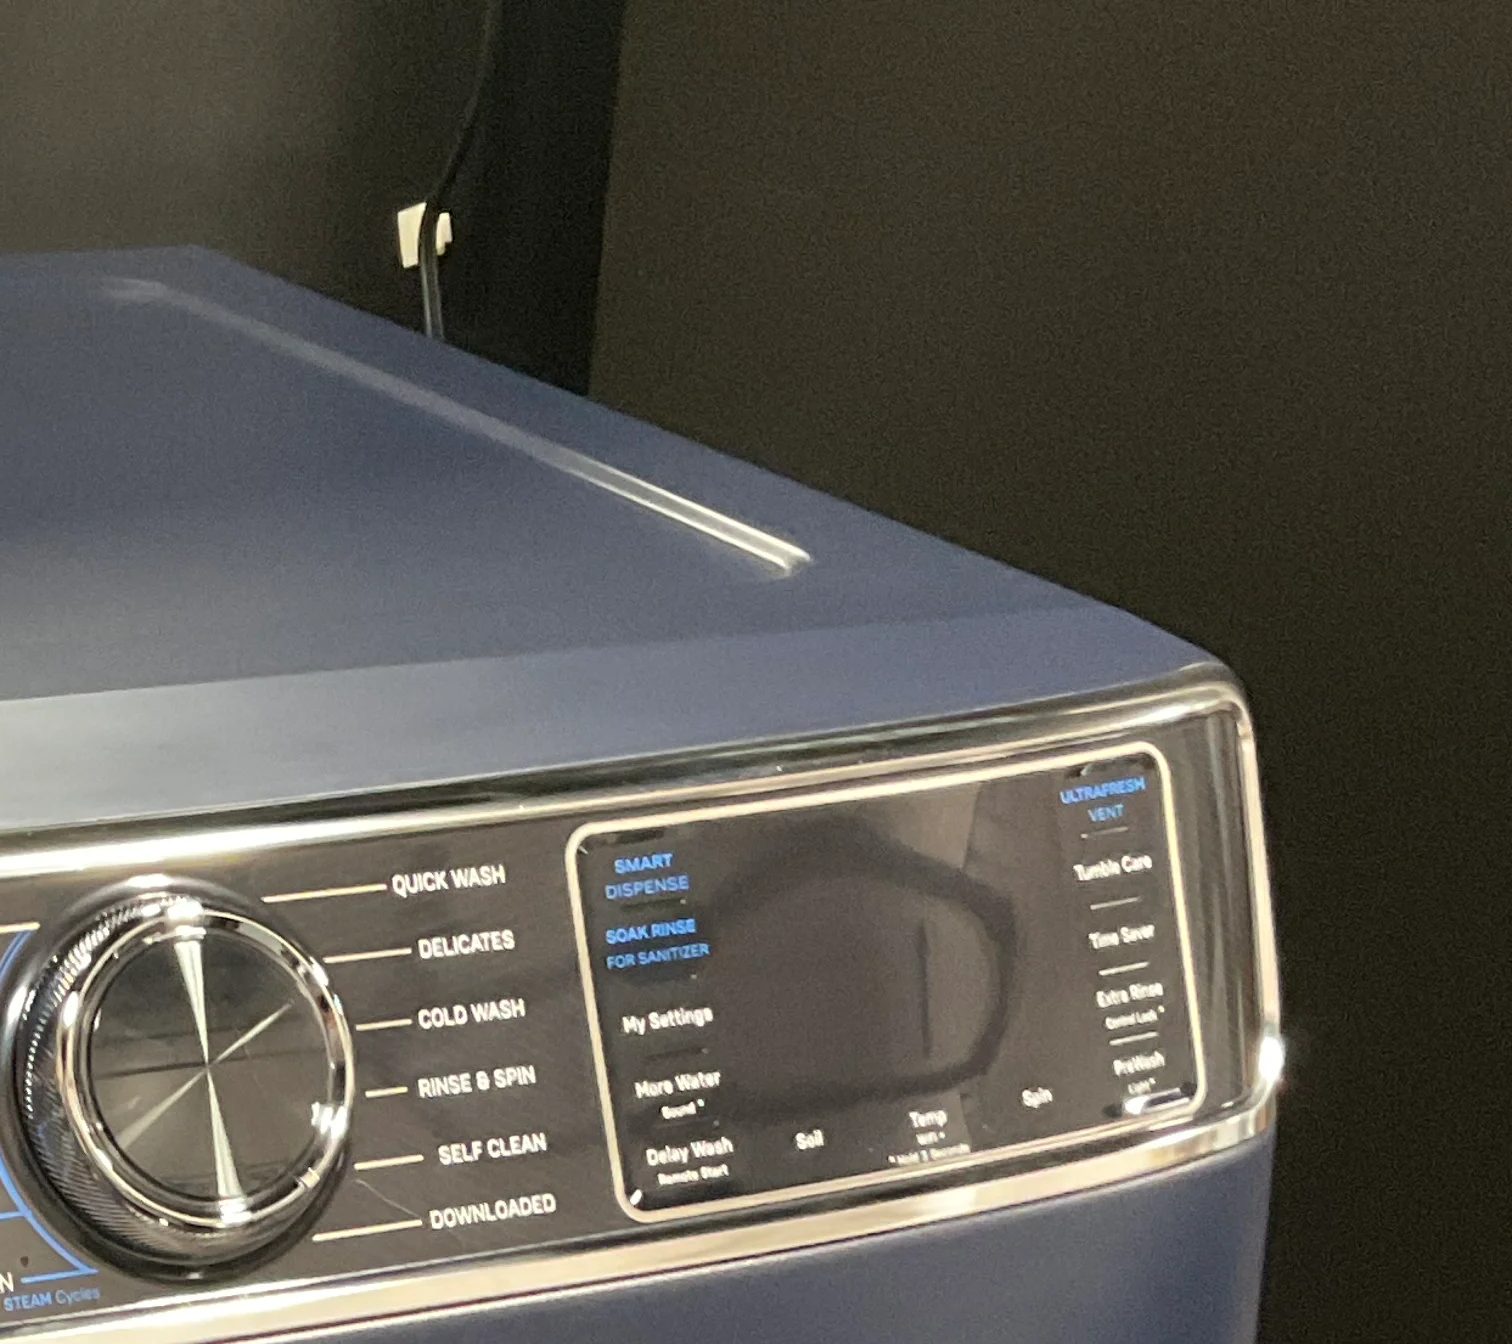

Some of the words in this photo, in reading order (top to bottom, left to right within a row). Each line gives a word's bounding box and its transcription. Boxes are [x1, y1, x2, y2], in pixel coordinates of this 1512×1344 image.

[1060, 776, 1146, 804] ULTRAFRESH
[1087, 804, 1124, 822] VENT
[614, 853, 673, 874] SMART
[1121, 855, 1153, 873] Care
[392, 871, 449, 898] QUICK
[450, 864, 506, 889] WASH
[605, 875, 689, 899] DISPENSE
[417, 929, 516, 959] DELICATES
[605, 926, 650, 945] SOAK
[651, 918, 697, 937] RINSE
[606, 954, 636, 970] FOR
[637, 943, 711, 965] SANITIZER
[417, 1004, 468, 1029] COLD
[470, 998, 526, 1023] WASH
[622, 1015, 646, 1036] My
[648, 1007, 714, 1030] Settings
[418, 1072, 473, 1099] RINSE
[493, 1065, 536, 1089] SPIN
[634, 1080, 674, 1099] More
[674, 1071, 721, 1092] Water
[438, 1140, 484, 1166] SELF
[486, 1132, 548, 1159] CLEAN
[646, 1144, 688, 1167] Delay
[689, 1136, 734, 1159] Wash
[795, 1128, 825, 1150] Soil
[429, 1193, 557, 1230] DOWNLOADED
[3, 1293, 53, 1313] STEAM
[54, 1287, 101, 1308] Cycles
